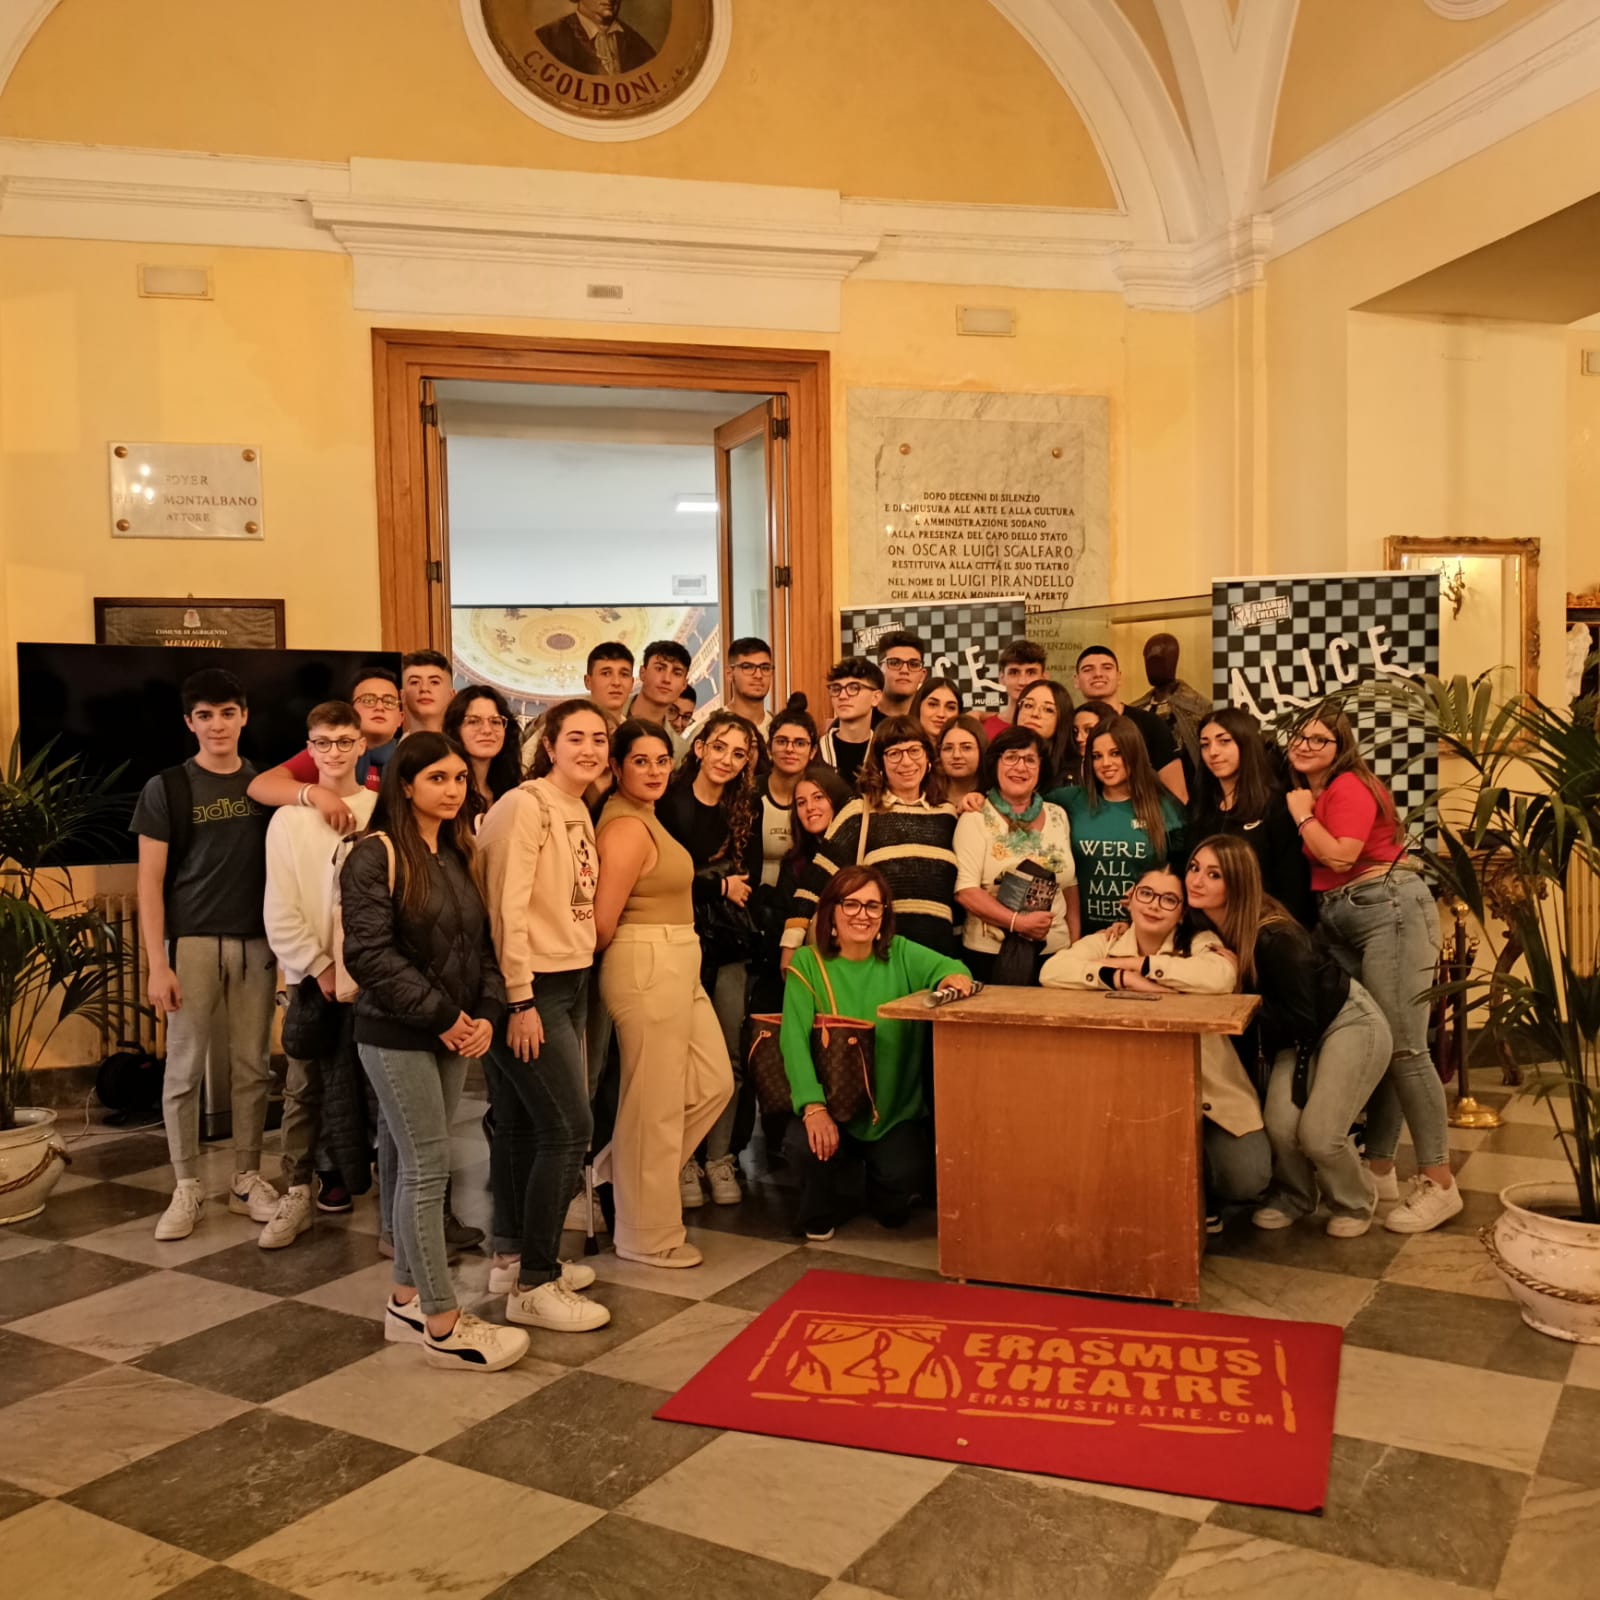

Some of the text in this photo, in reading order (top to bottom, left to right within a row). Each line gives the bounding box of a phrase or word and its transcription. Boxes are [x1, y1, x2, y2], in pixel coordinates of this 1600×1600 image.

[163, 495, 257, 507] MONTALBANO
[924, 491, 1040, 503] DOPO DECENNI DI SILENZIO
[885, 503, 890, 512] E
[905, 504, 950, 513] CHIUSURA
[973, 505, 997, 515] ARTE
[1000, 506, 1006, 515] E
[1009, 506, 1032, 515] ALLA
[1034, 507, 1075, 516] CULTURA
[923, 518, 1008, 528] AMMINISTRAZIONE
[1011, 520, 1047, 529] SODANO
[891, 530, 1068, 541] ALLA PRESENZA DEL CAPO DELLO STATO
[912, 543, 957, 557] OSCAR
[963, 544, 999, 557] LUIGI
[1003, 545, 1073, 558] SCALFARO
[892, 560, 946, 569] RESTITUIVA
[949, 561, 973, 569] ALLA
[1004, 562, 1012, 570] IL
[1014, 562, 1032, 570] SUO
[1034, 562, 1069, 571] TEATRO
[888, 574, 1074, 588] NEL NOME DI LUIGI PIRANDELLO
[891, 590, 908, 599] CHE
[912, 591, 935, 600] ALLA
[938, 591, 967, 600] SCENA
[1034, 591, 1069, 601] APERTO
[1027, 628, 1060, 638] ENTICA
[164, 639, 224, 649] MEMORIAL
[1231, 624, 1426, 721] ALICE
[192, 796, 262, 823] adida
[1093, 860, 1131, 877] ALL
[1089, 880, 1136, 896] MAD
[1087, 898, 1126, 917] HER
[963, 1332, 1263, 1377] ERASMUS
[975, 1360, 1255, 1407] THEATRE
[967, 1391, 1275, 1426] ERASMUSTHEATRE.COM
